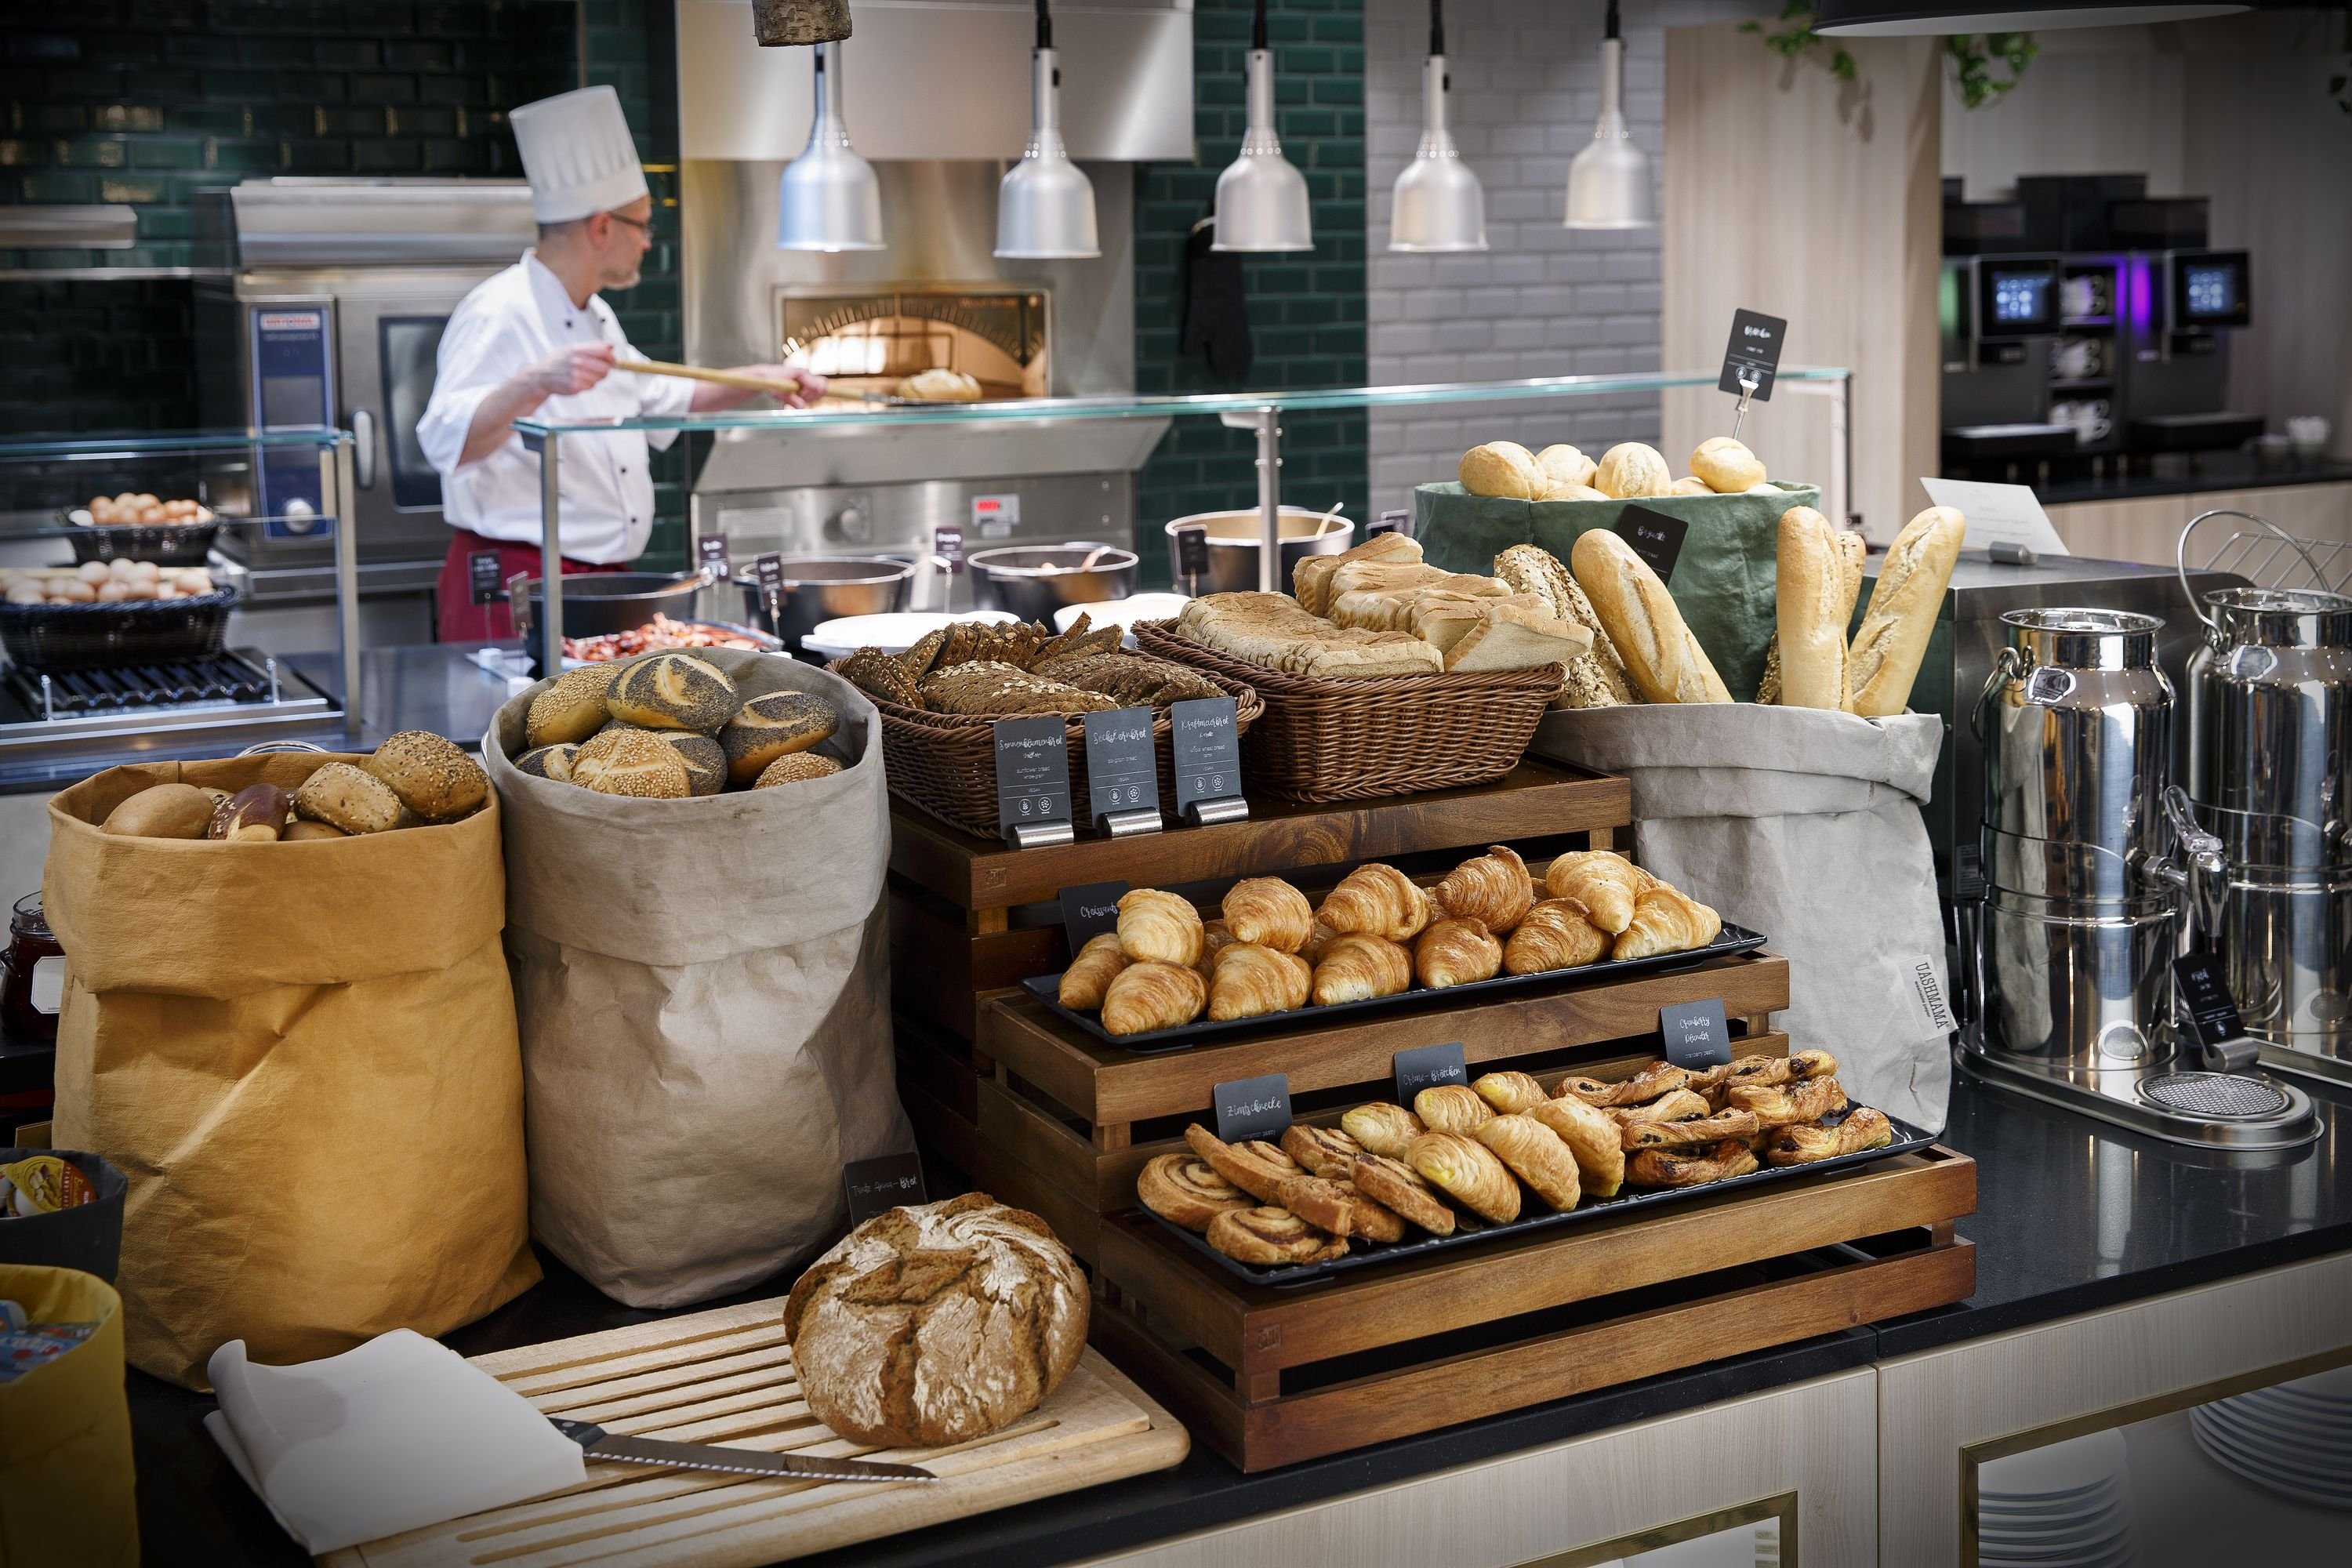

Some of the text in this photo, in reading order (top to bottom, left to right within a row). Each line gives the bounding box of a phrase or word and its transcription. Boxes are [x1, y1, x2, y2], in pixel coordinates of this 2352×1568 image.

[1000, 735, 1063, 751] Sonnenblumenbrot
[1093, 727, 1147, 745] Sechskornbrot
[1080, 902, 1118, 918] Croissants
[1915, 962, 1950, 1029] UASHMAMA
[1679, 1016, 1711, 1029] Cranberry
[1227, 1096, 1282, 1117] Zimtschnecke
